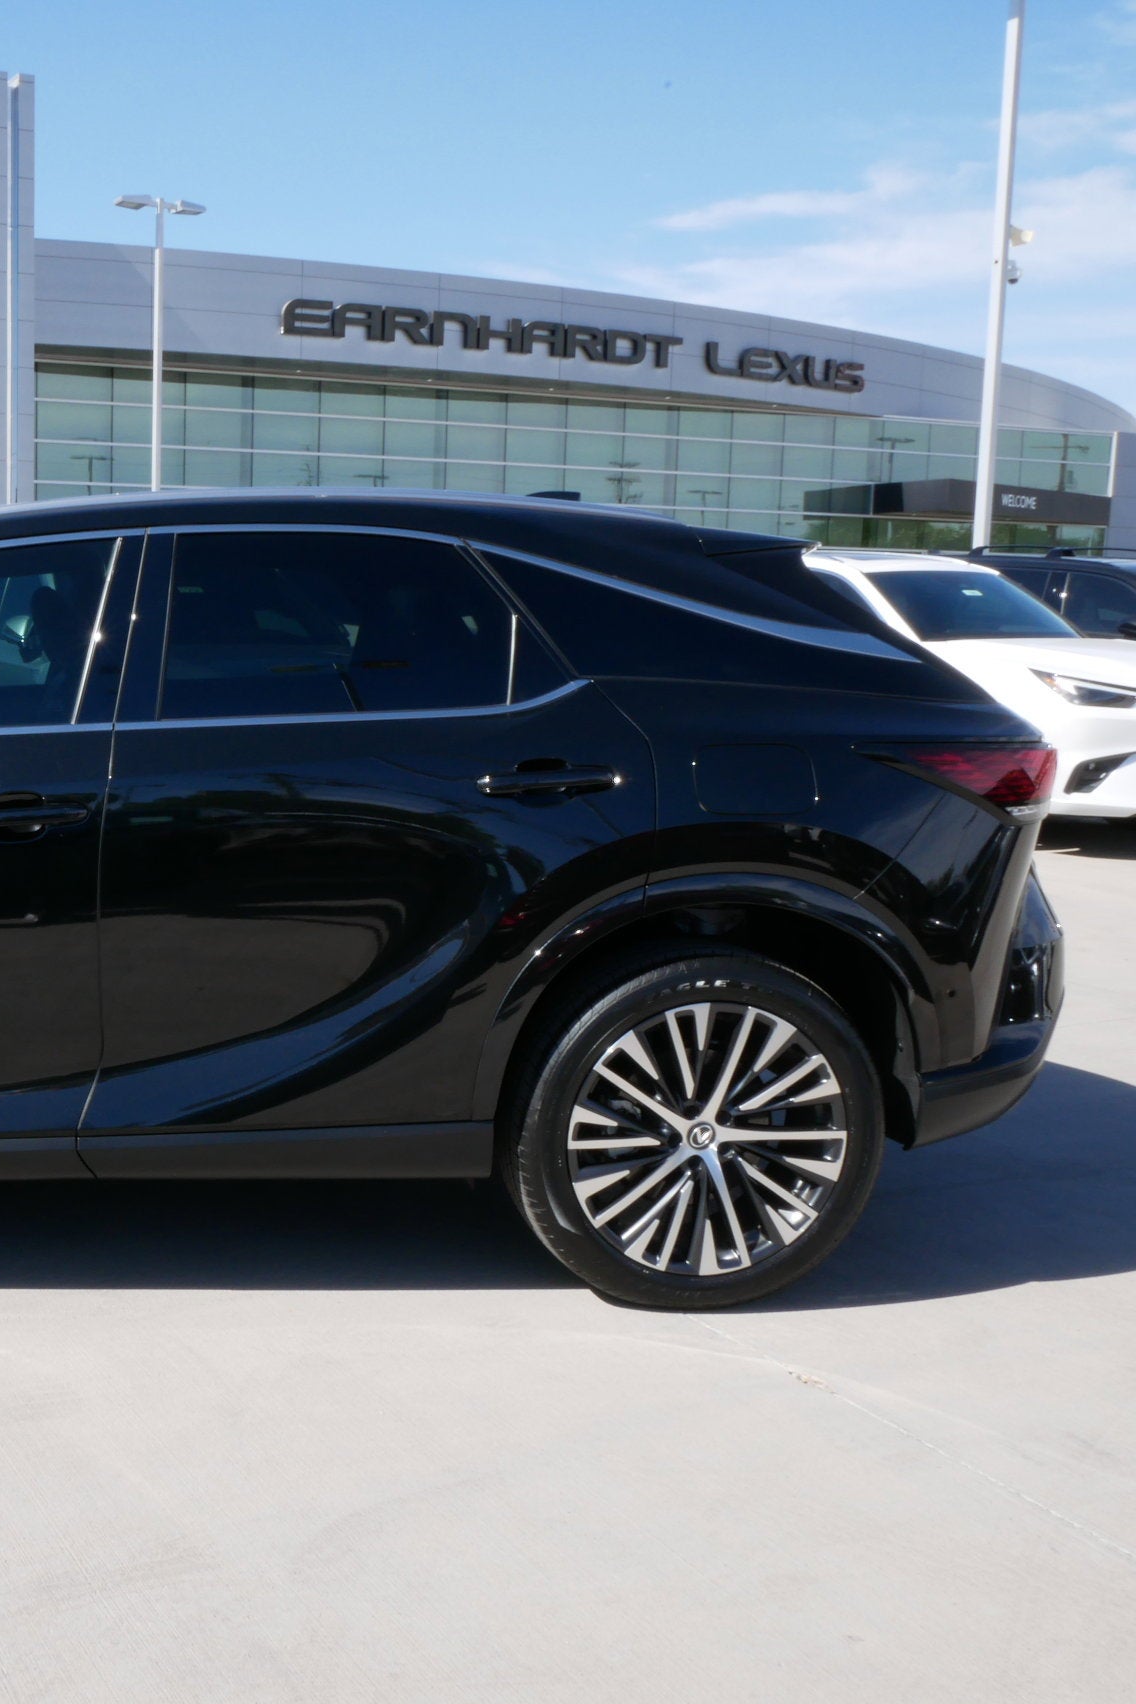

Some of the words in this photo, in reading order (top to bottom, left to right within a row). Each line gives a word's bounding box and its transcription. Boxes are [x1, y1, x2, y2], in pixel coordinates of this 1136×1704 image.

[281, 298, 683, 369] EARNHARDT
[705, 341, 865, 394] LEXUS
[1001, 493, 1037, 510] WELCOME
